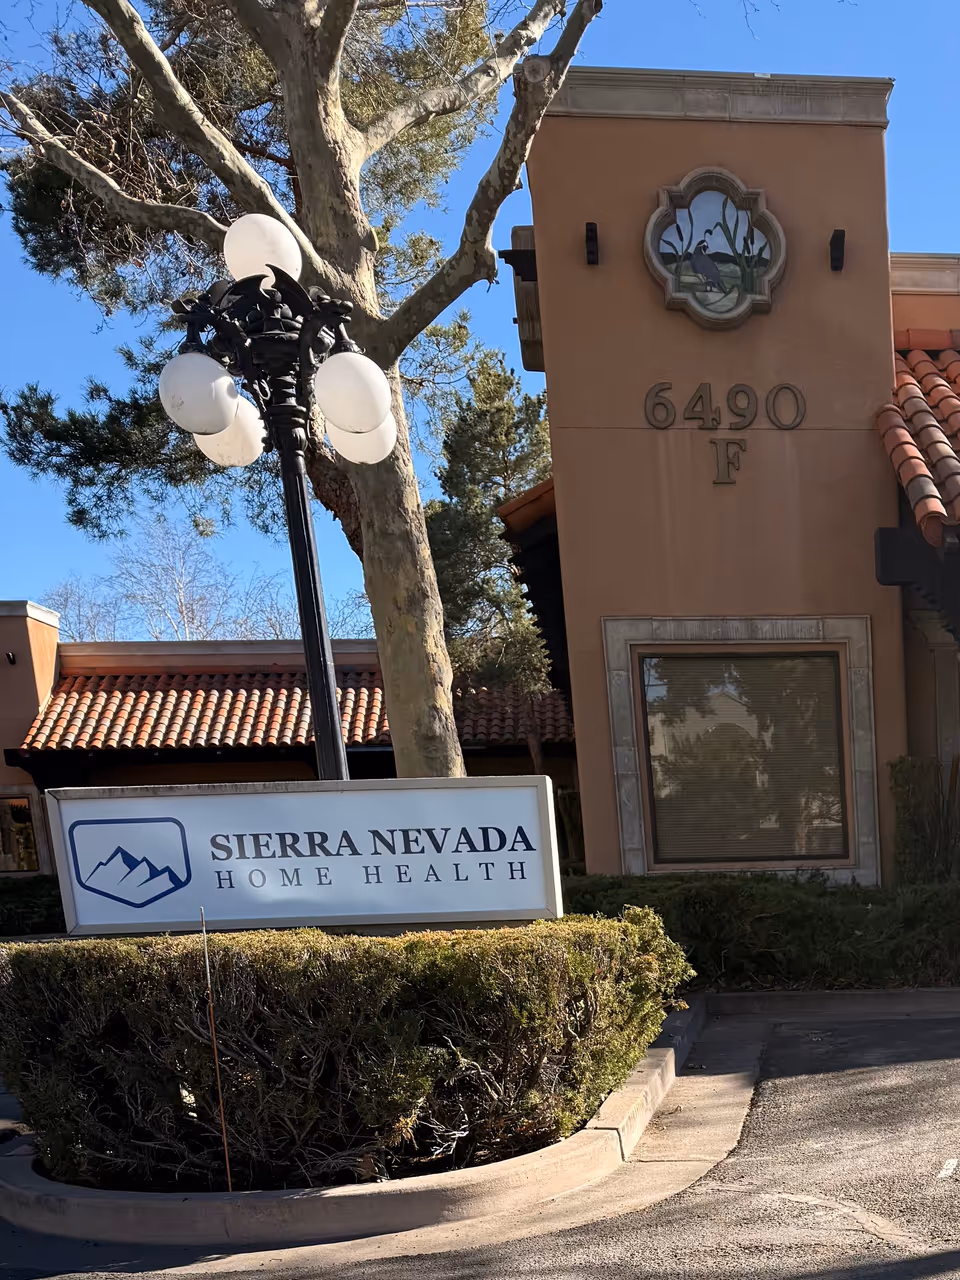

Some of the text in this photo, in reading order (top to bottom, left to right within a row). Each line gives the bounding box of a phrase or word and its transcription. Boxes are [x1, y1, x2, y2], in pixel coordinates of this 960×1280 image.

[644, 382, 806, 430] 6490
[709, 438, 747, 484] F
[210, 825, 537, 861] SIERRA NEVADA
[214, 861, 528, 889] HOME HEALTH
